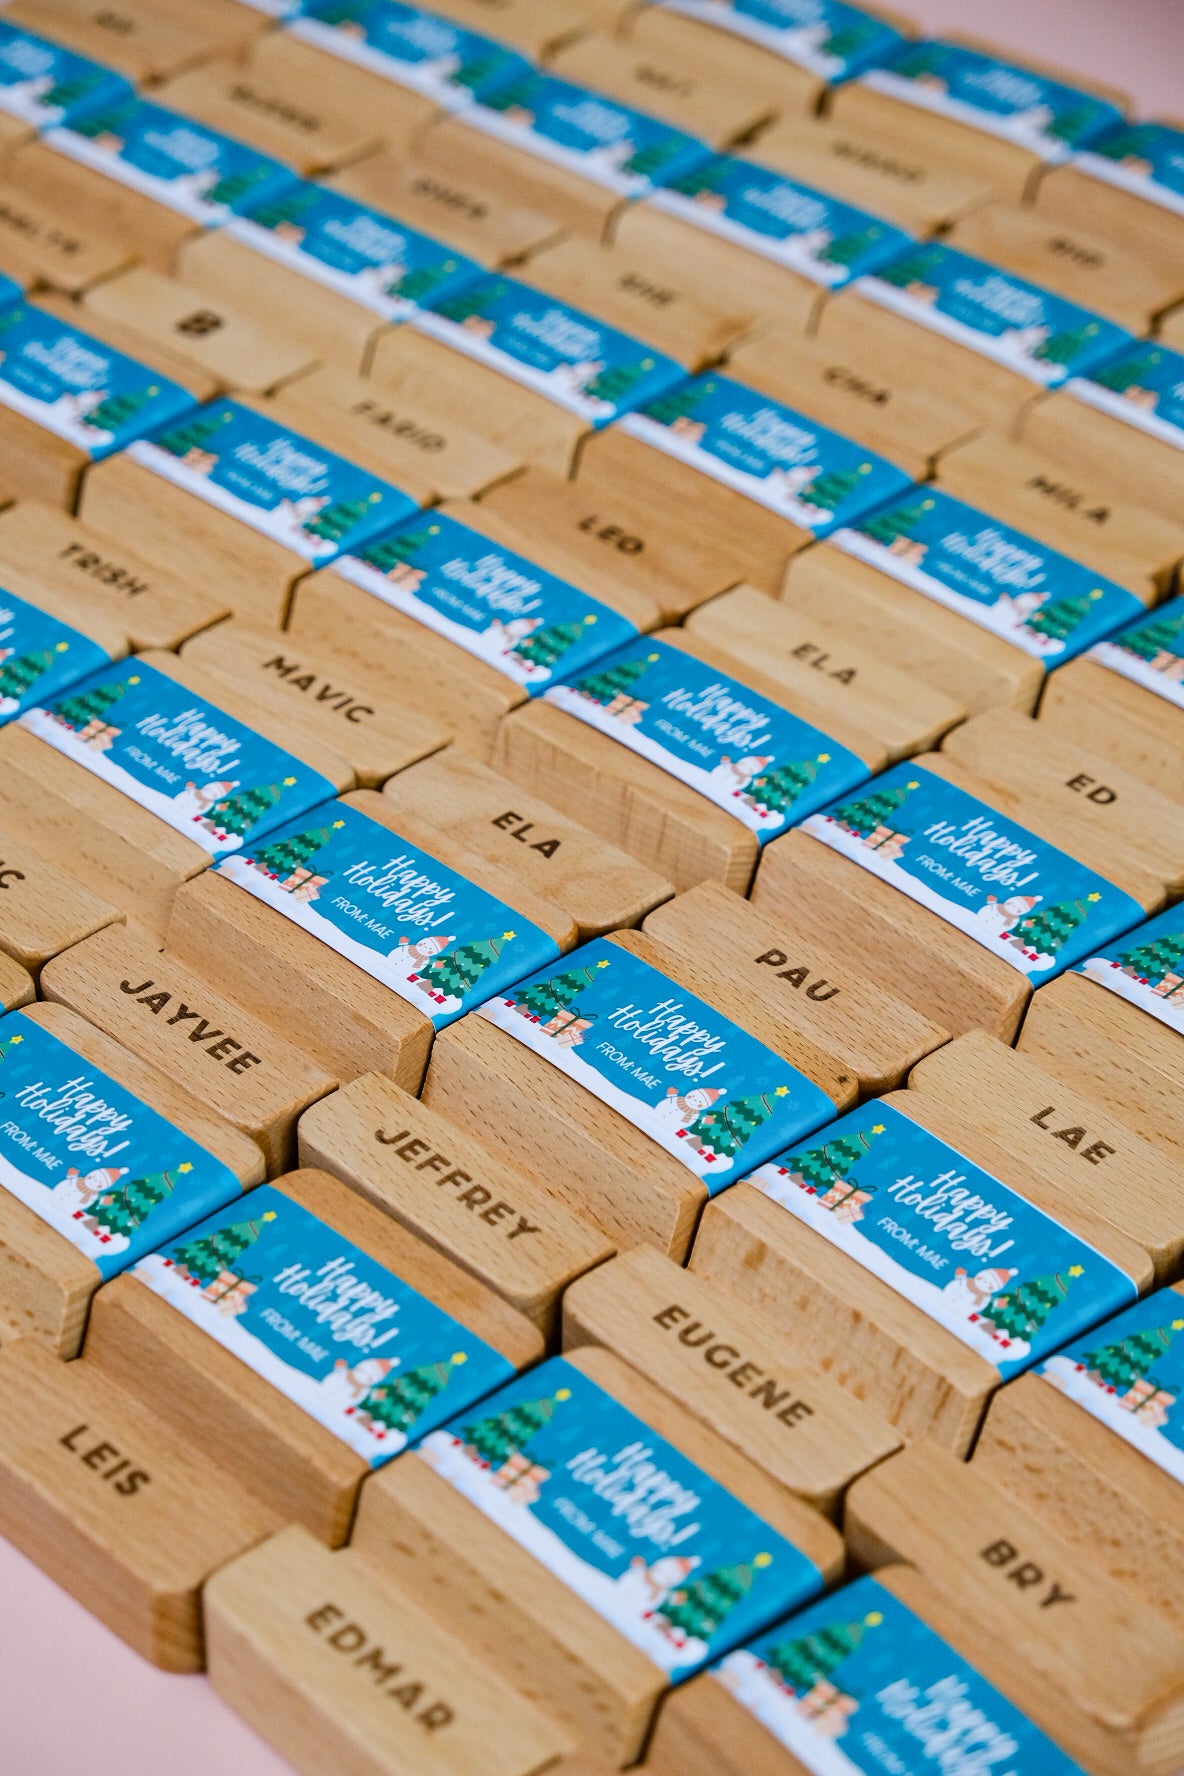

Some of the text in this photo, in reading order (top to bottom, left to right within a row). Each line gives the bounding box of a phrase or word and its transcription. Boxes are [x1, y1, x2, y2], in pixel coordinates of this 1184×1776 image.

[578, 515, 646, 556] LEO
[60, 542, 148, 597] TRISH
[262, 655, 375, 724] MAVIC
[790, 642, 858, 686] ELA
[172, 708, 241, 757] Happy
[1065, 772, 1118, 806] ED
[491, 810, 562, 860] ELA
[923, 820, 1039, 891] Holidays!
[961, 816, 1038, 868] Happy
[343, 860, 456, 931] Holidays!
[381, 854, 456, 907] Happy
[330, 896, 395, 939] FROM: MAE
[753, 948, 841, 1003] PAU
[120, 977, 262, 1076] JAYVEE
[607, 1003, 726, 1083] Holidays!
[648, 998, 727, 1056] Happy
[595, 1041, 662, 1089] FROM: MAE
[15, 1081, 131, 1162] Holidays!
[56, 1076, 133, 1135] Happy
[1029, 1105, 1117, 1166] LAE
[0, 1121, 64, 1171] FROM: MAE
[374, 1128, 542, 1242] JEFFREY
[929, 1169, 1014, 1234] Happy
[887, 1174, 1015, 1263] Holidays!
[915, 1245, 950, 1270] MAE
[315, 1256, 400, 1324] Happy
[652, 1304, 815, 1429] EUGENE
[58, 1424, 152, 1498] LEIS
[979, 1538, 1076, 1610] BRY
[304, 1602, 456, 1734] EDMAR
